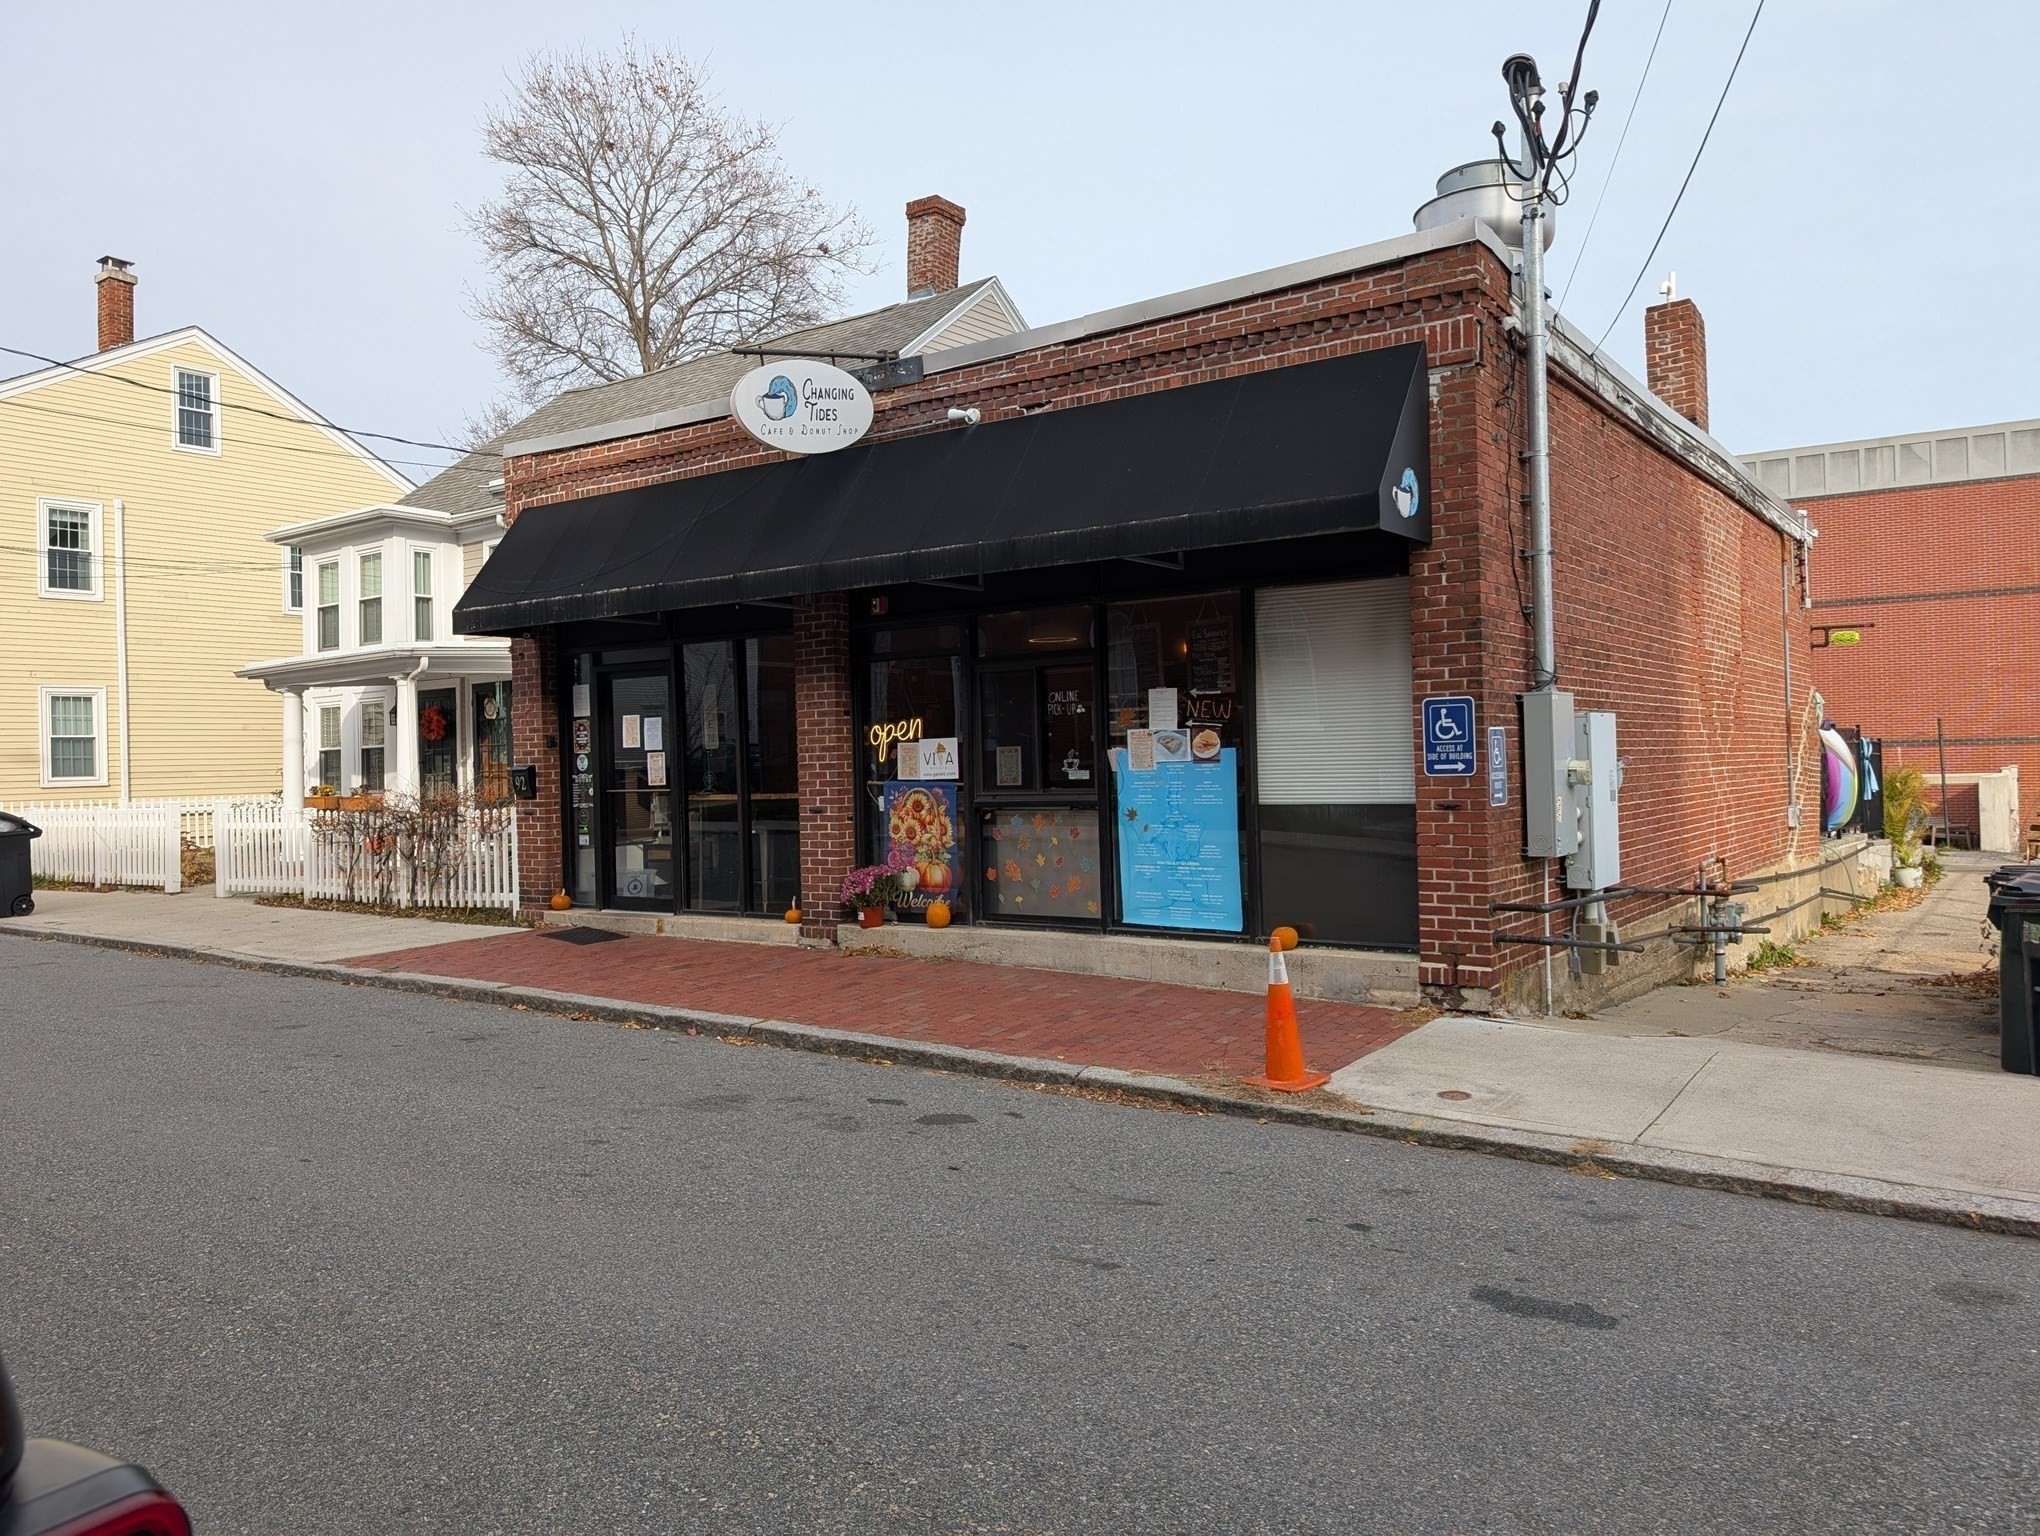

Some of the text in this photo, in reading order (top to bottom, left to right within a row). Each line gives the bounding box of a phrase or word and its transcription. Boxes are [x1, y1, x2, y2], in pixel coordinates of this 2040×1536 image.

[803, 378, 854, 401] CHANGING
[804, 401, 838, 421] TIDES
[761, 424, 859, 435] CAFE & DONUT SHOP
[1048, 690, 1080, 703] ONLINE
[1187, 699, 1232, 719] NEW
[870, 718, 922, 762] open
[1427, 753, 1438, 761] SIDE
[1449, 752, 1473, 760] BUILDING
[514, 776, 527, 791] 92
